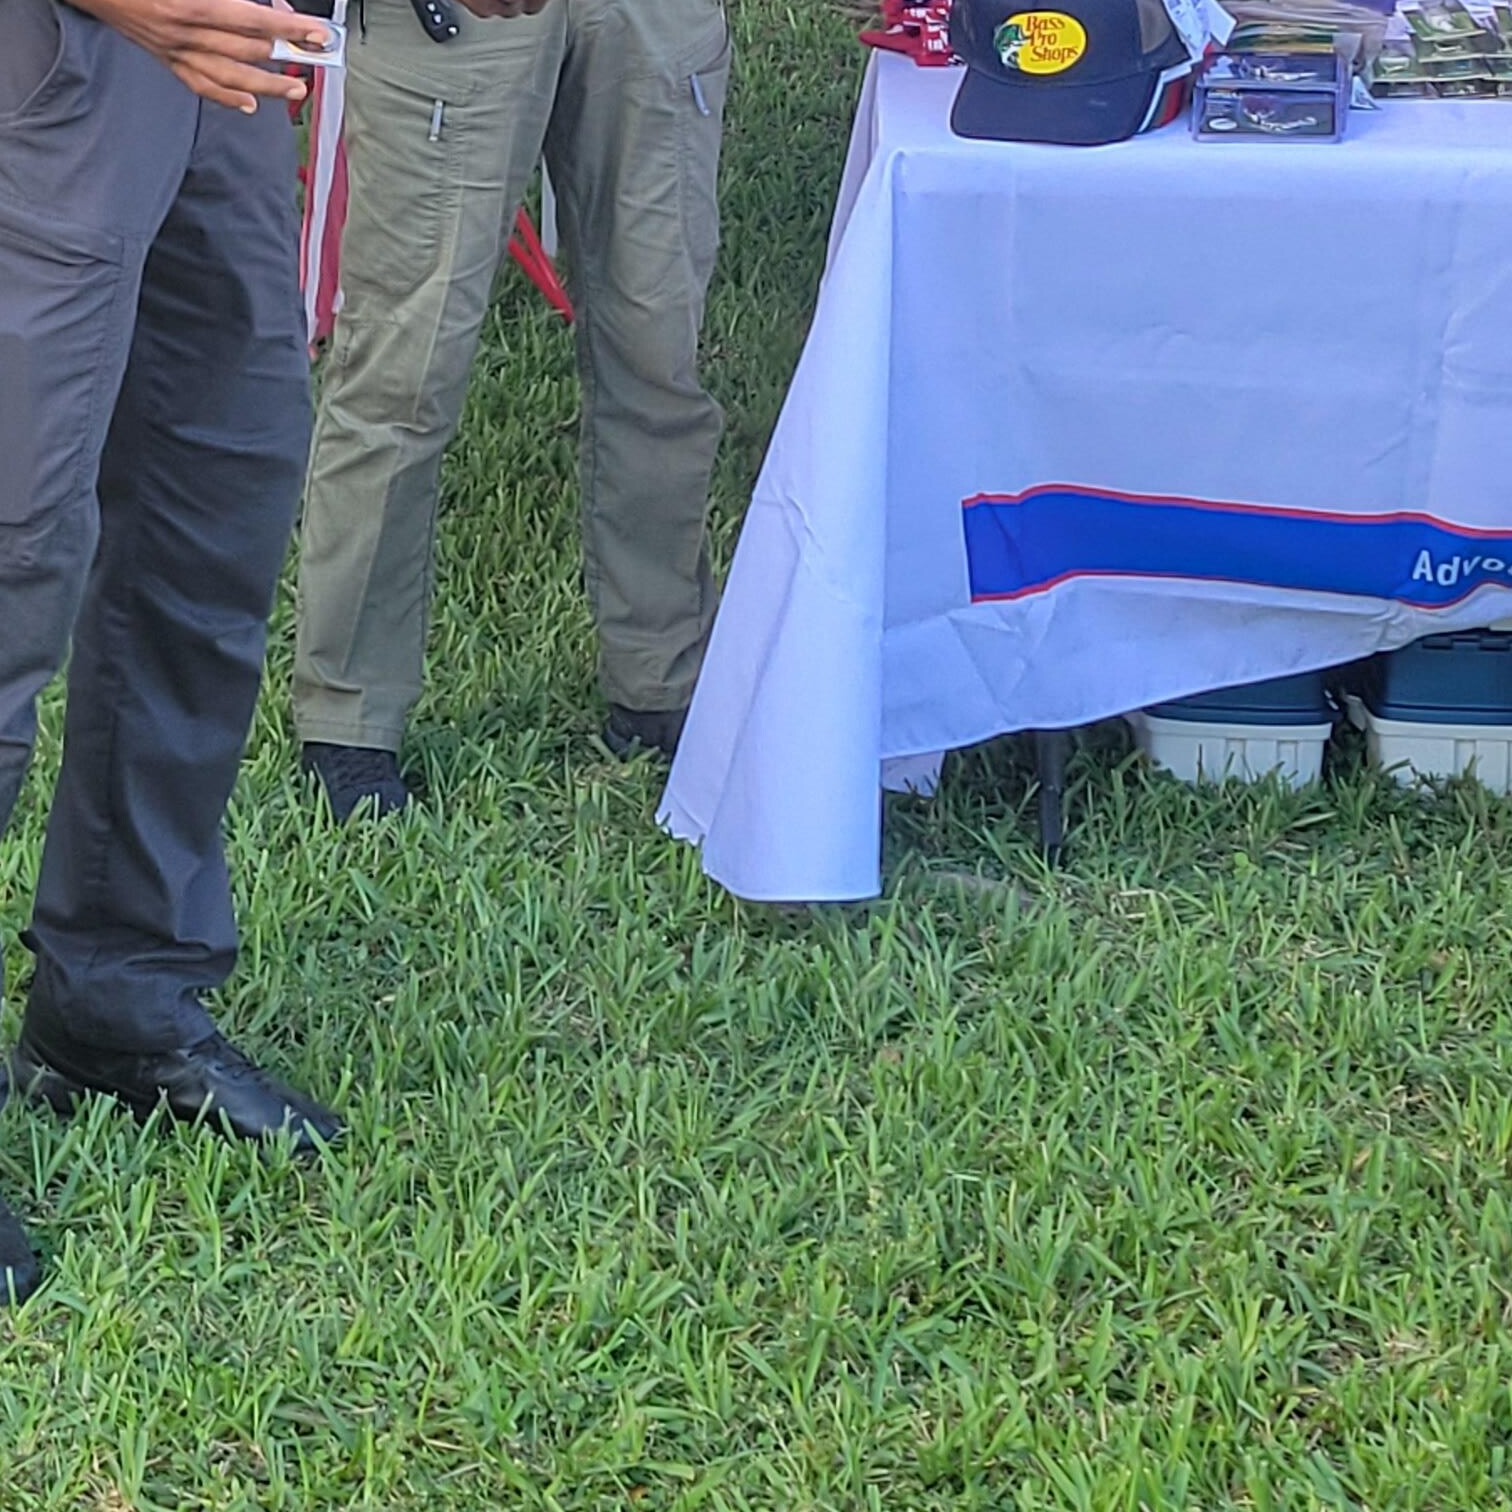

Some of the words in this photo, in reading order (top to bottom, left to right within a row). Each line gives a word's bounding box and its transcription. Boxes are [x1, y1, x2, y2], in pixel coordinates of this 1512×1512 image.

[1026, 16, 1066, 31] Bass
[1029, 31, 1057, 46] Pro
[1030, 46, 1079, 64] Shops
[1412, 549, 1512, 586] Advo
